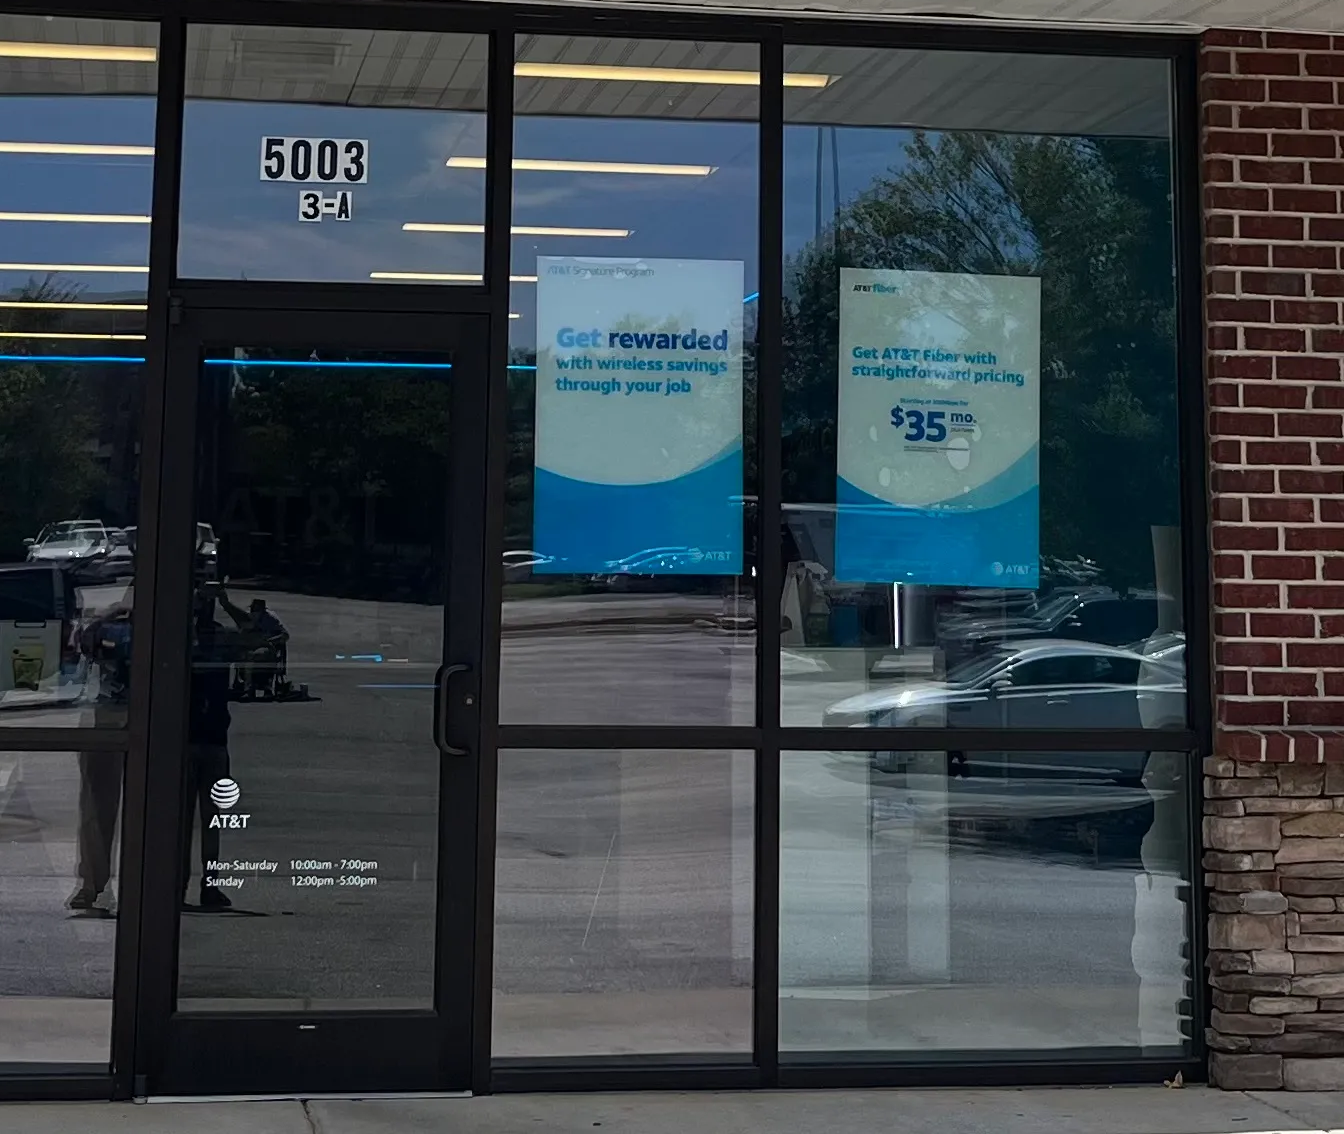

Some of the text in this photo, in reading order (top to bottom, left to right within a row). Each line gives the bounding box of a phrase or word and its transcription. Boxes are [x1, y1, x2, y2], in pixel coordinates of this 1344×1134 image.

[264, 138, 365, 182] 5003
[301, 192, 351, 220] 3-A
[853, 284, 872, 293] AT&T
[556, 327, 729, 351] Get rewarded
[852, 346, 997, 365] Get AT&T Fiber with
[556, 355, 728, 376] with wireless savings
[851, 364, 1025, 387] straightforward pricing
[555, 377, 692, 396] through your job
[890, 405, 977, 442] $35 mo.
[704, 551, 732, 561] AT&T
[1005, 565, 1031, 575] AT&T
[209, 814, 251, 829] AT&T
[206, 860, 278, 872] Mon-Saturday
[290, 860, 331, 870] 10:00am
[340, 860, 378, 872] 7:00pm
[206, 876, 244, 889] Sunday
[291, 876, 334, 888] 12:00pm
